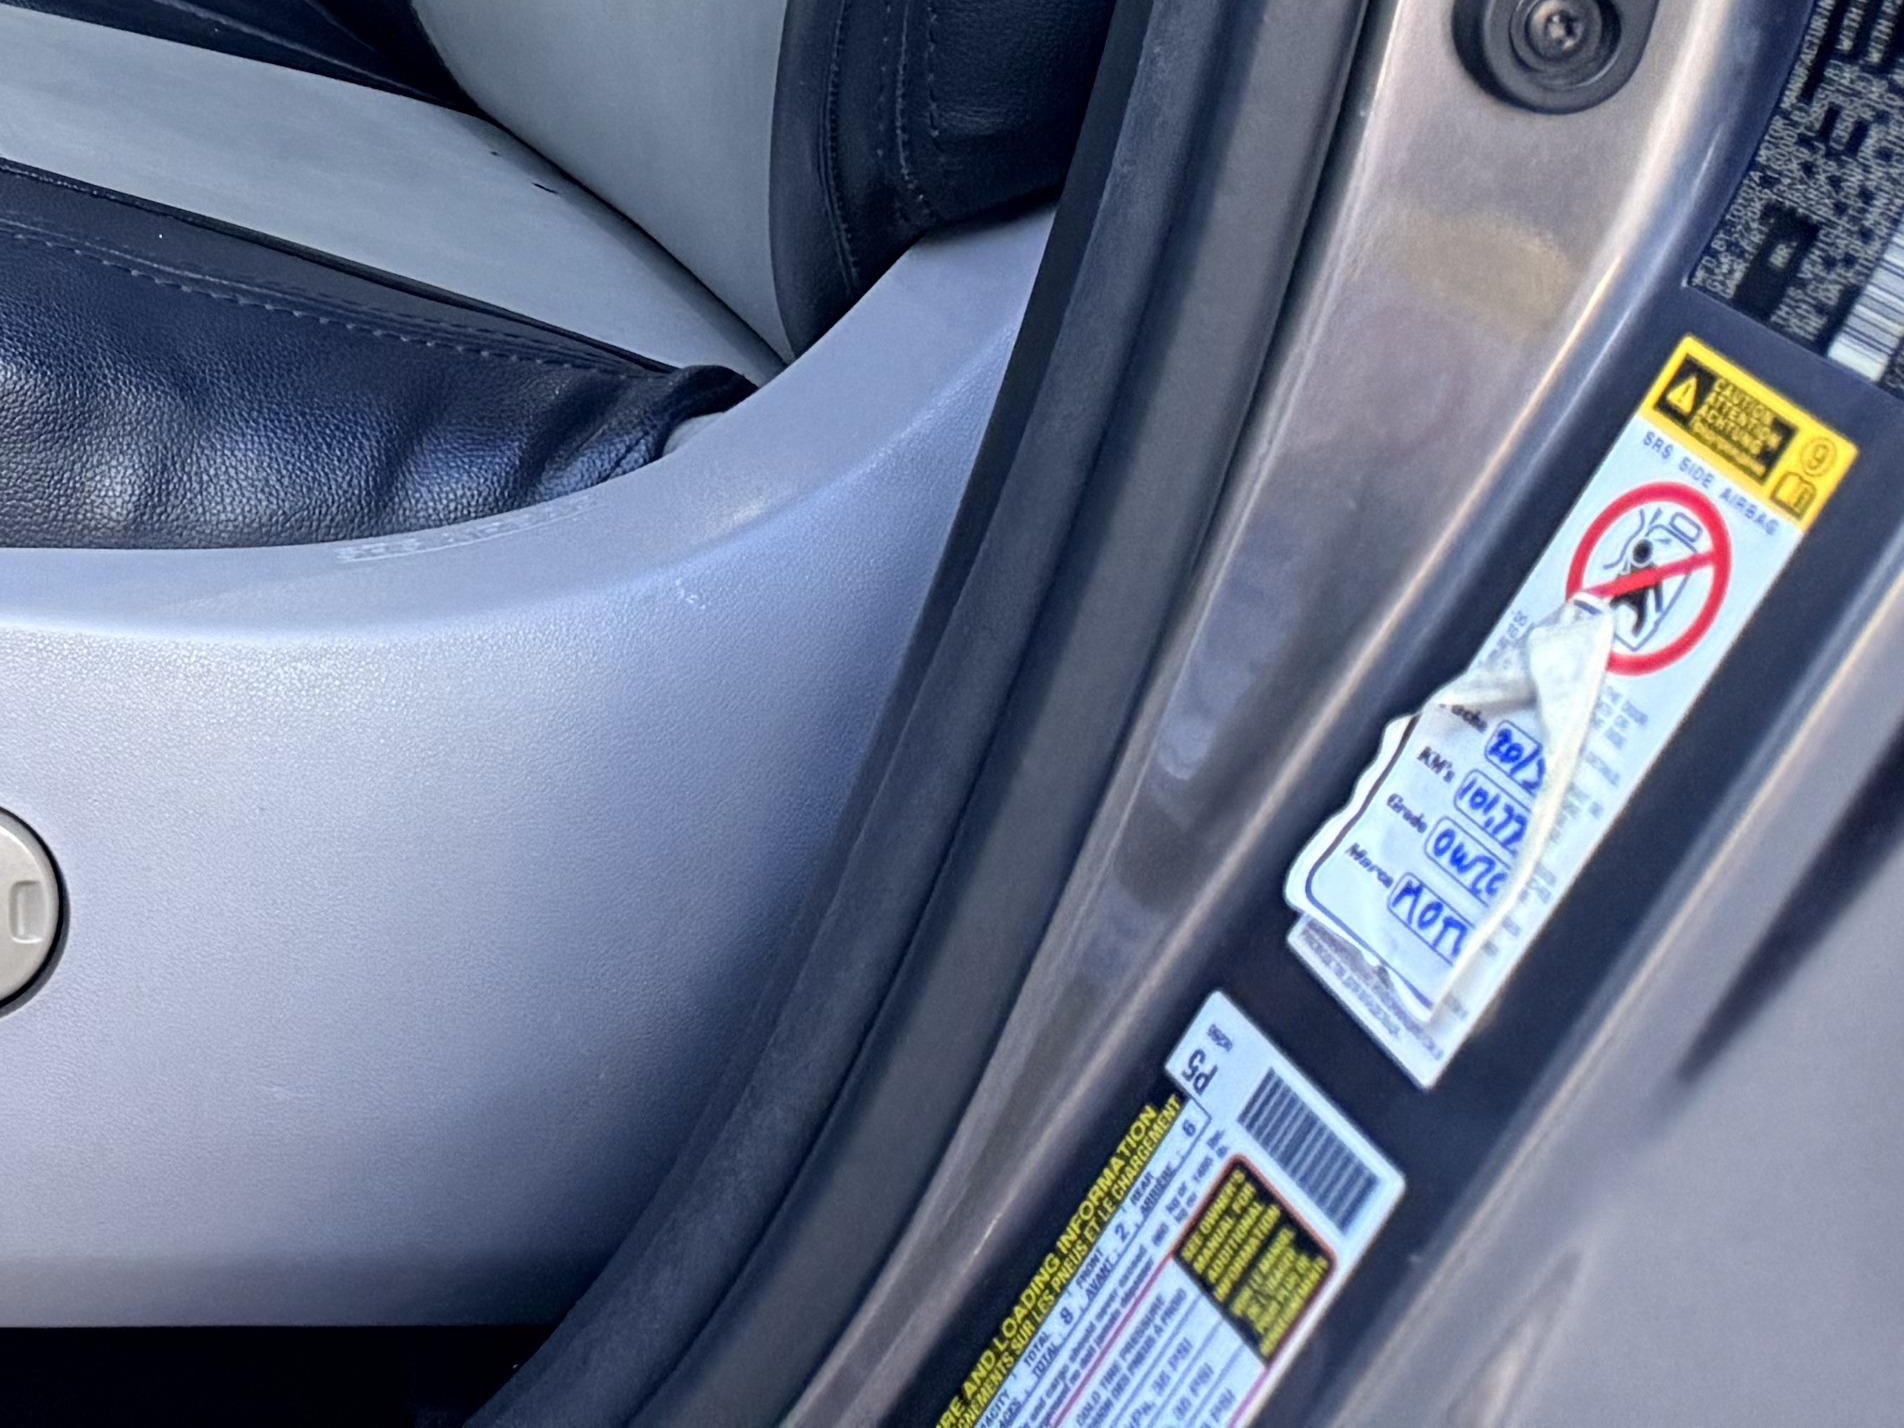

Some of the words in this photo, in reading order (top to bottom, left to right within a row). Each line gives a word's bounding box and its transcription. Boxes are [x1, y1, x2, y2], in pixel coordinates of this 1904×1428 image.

[1712, 378, 1776, 425] CAUTION
[1640, 431, 1674, 459] SRS
[1677, 457, 1715, 488] SIDE
[1718, 487, 1781, 534] AIRBAG
[1181, 1047, 1220, 1094] P5
[960, 1349, 999, 1399] AND
[993, 1255, 1060, 1348] LOADING
[1057, 1111, 1156, 1248] INFORMATION
[1009, 1320, 1036, 1354] SUR
[1030, 1289, 1055, 1321] LES
[1049, 1240, 1087, 1290] PNEUS
[1082, 1216, 1103, 1242] ET
[1096, 1195, 1116, 1221] LE
[1110, 1098, 1181, 1196] CHARGEMENT
[1057, 1305, 1074, 1326] 8
[1113, 1221, 1130, 1241] 2
[1180, 1118, 1197, 1138] 6
[1192, 1216, 1234, 1272] MANUAL
[1230, 1182, 1256, 1213] FOR
[1206, 1202, 1263, 1280] ADDITIONAL
[1214, 1207, 1279, 1298] INFORMATION
[1024, 1330, 1050, 1366] TOTAL
[1075, 1248, 1104, 1287] FRONT
